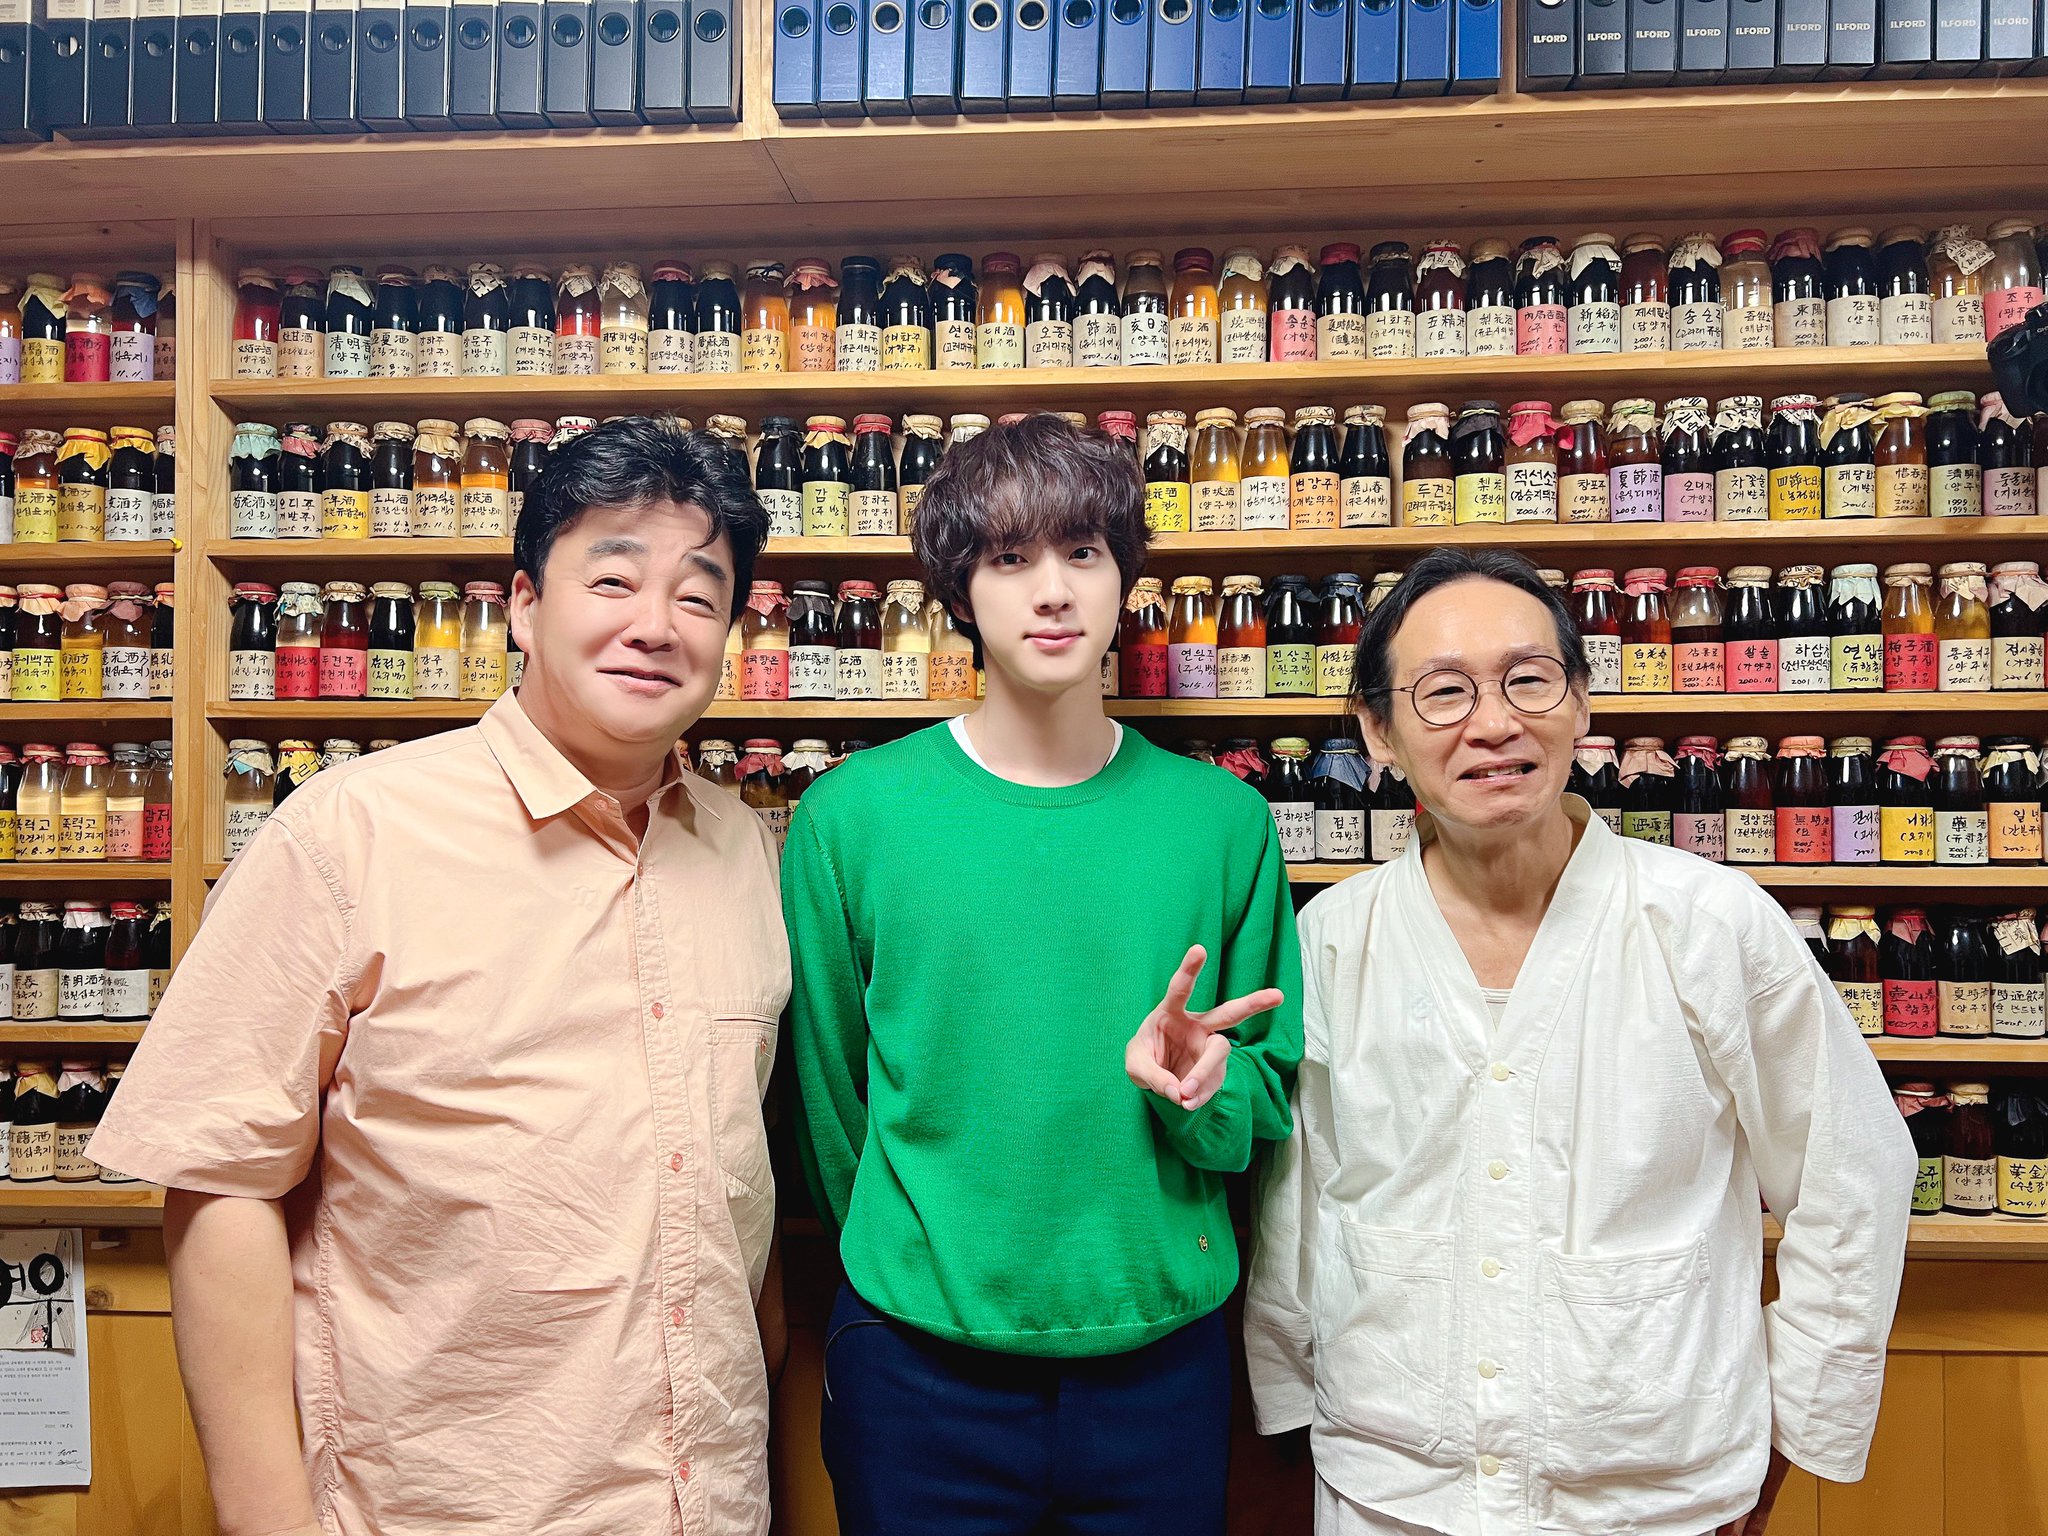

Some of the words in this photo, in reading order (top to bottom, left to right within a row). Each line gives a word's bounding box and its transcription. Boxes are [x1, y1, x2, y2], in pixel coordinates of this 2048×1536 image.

[1890, 19, 1926, 29] ILFORD
[1941, 18, 1977, 28] ILFORD
[1994, 16, 2029, 26] ILFORD
[1736, 26, 1771, 36] ILFORD
[1787, 22, 1822, 31] ILFORD
[1836, 22, 1871, 31] ILFORD
[1587, 32, 1622, 42] ILFORD
[1636, 30, 1671, 39] ILFORD
[1686, 28, 1722, 37] ILFORD
[1533, 34, 1568, 44] ILFORD
